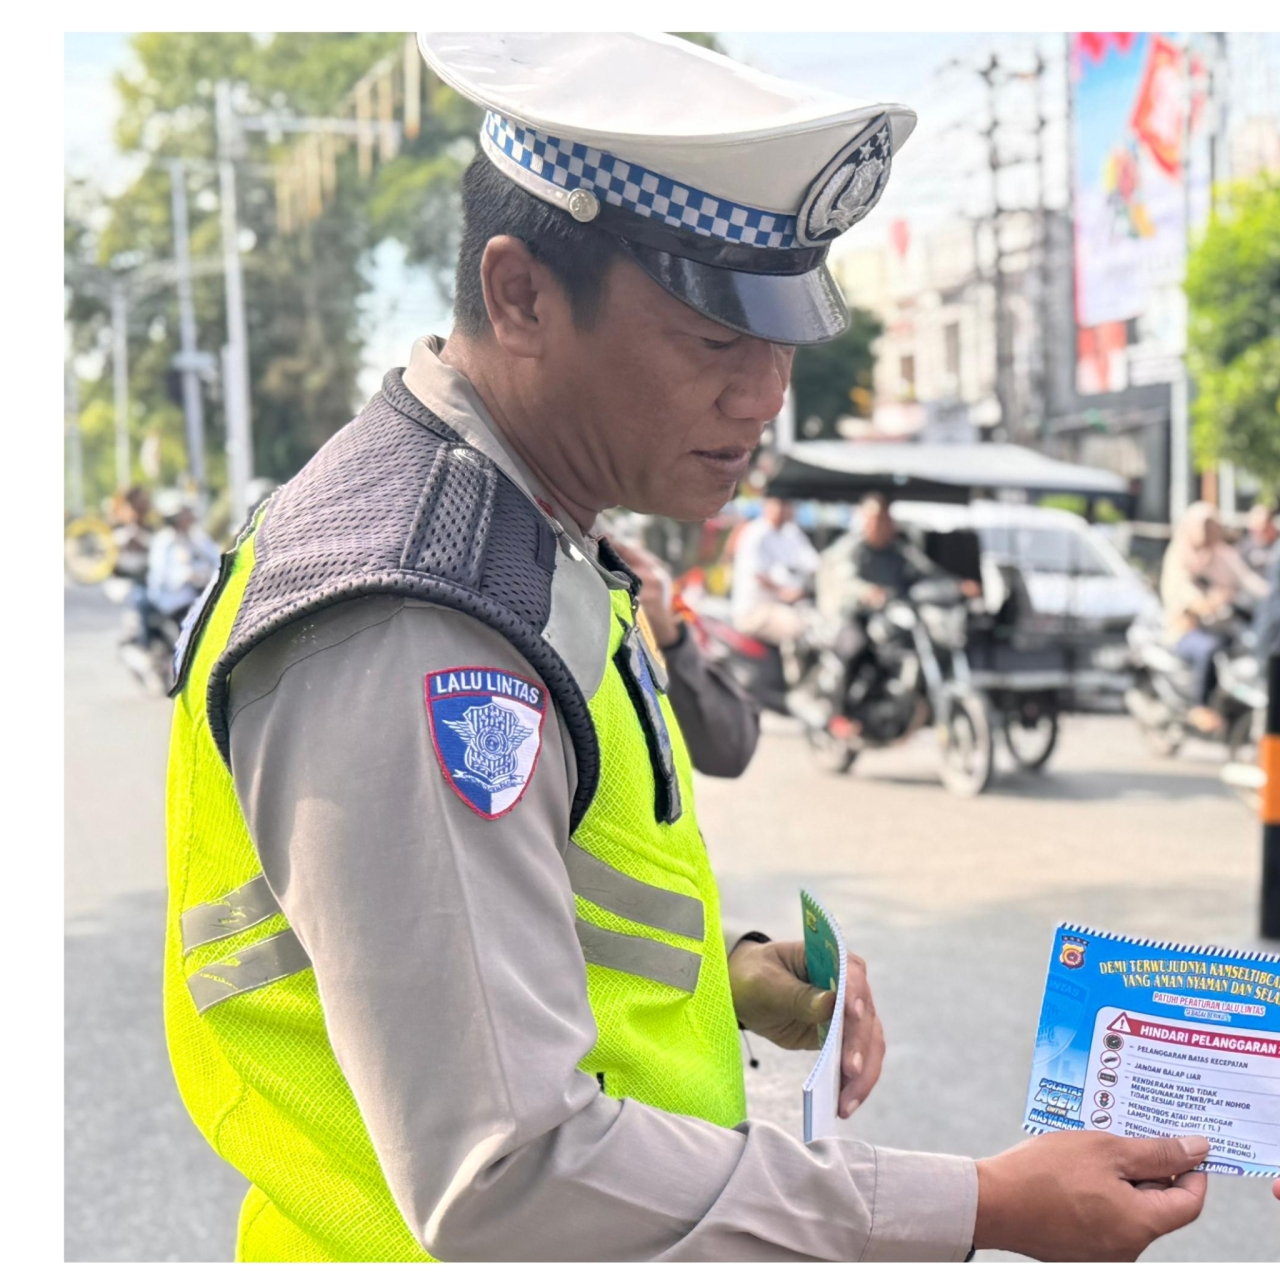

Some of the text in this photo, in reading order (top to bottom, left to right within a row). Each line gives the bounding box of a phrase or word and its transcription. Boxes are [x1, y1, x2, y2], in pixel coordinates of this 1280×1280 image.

[436, 672, 540, 704] LALU LINTAS
[1099, 960, 1127, 974] DEMI
[1129, 959, 1207, 973] TERWUJUDNYA
[1122, 974, 1151, 988] YANG
[1153, 974, 1183, 989] AMAN
[1186, 976, 1229, 993] NYAMAN
[1230, 980, 1253, 997] DAN
[1153, 992, 1266, 1017] PATUHI PERATURAN LALU LINTAS
[1140, 1025, 1189, 1043] HINDARI
[1137, 1045, 1249, 1069] PELANGGARAN BATAS KECEPATAN
[1134, 1063, 1202, 1081] JANGAN BALAP LIAR
[1040, 1079, 1083, 1096] POLANTAS
[1132, 1076, 1218, 1097] KENDERAAN YANG TIDAK
[1034, 1087, 1083, 1112] ACEH
[1130, 1091, 1150, 1101] TIDAK
[1151, 1096, 1175, 1106] SESUAI
[1185, 1095, 1224, 1107] TNKB/PLAT
[1225, 1101, 1251, 1110] NOMOR
[1127, 1110, 1151, 1120] LAMPU
[1152, 1115, 1180, 1127] TRAFFIC
[1181, 1121, 1201, 1130] LIGHT
[1128, 1101, 1234, 1127] MENEROBOS ATAU MELANGGAR
[1226, 1140, 1252, 1150] SESUAI
[1205, 1162, 1240, 1175] LANGSA
